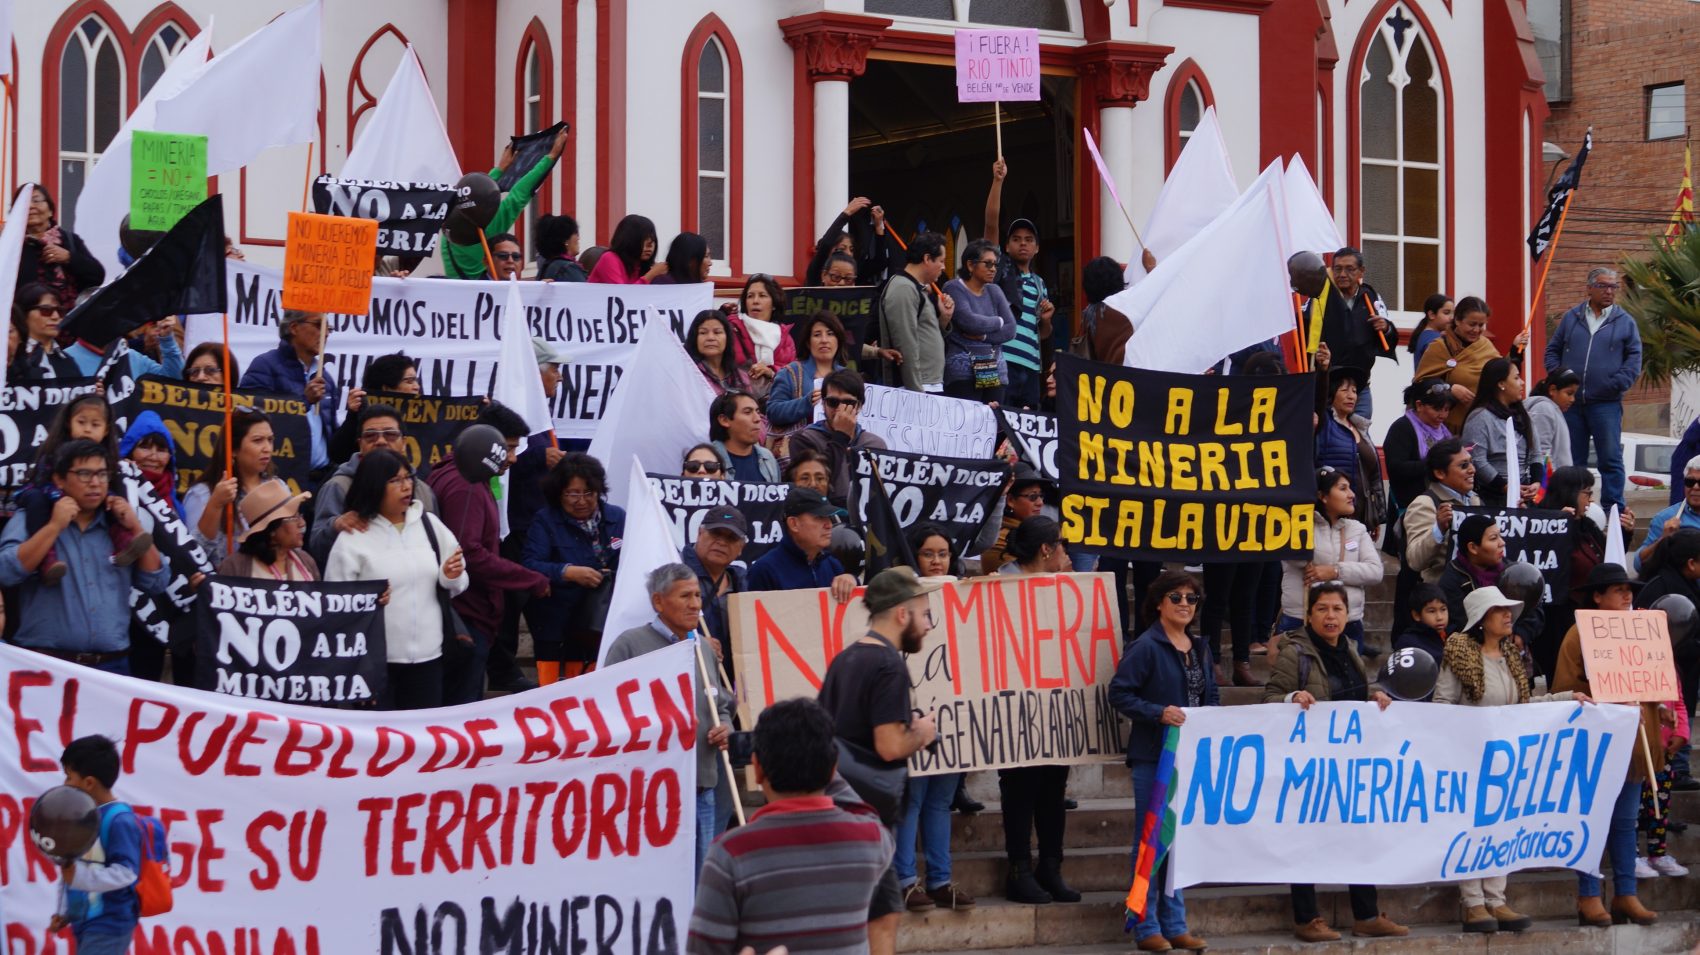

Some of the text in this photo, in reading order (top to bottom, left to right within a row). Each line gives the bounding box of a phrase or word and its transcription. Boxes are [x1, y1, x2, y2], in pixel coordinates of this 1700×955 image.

[968, 57, 1033, 80] RIO TINTO
[967, 81, 992, 93] BELÉN
[1012, 82, 1034, 93] VENDE
[325, 184, 391, 223] NO
[400, 203, 418, 220] A
[422, 203, 449, 220] LA
[295, 219, 312, 239] NO
[377, 229, 441, 252] ERIA
[344, 247, 360, 267] EN
[235, 273, 686, 344] MADOMOS DEL PUBLO DE BEN
[829, 298, 872, 316] DICE
[445, 404, 480, 421] DICE
[1077, 373, 1278, 436] NO A LA
[1003, 409, 1059, 438] BEL
[856, 450, 1004, 488] BELÉN DICE
[1078, 430, 1291, 491] MINERIA
[744, 484, 789, 503] DICE
[929, 499, 948, 521] A
[953, 502, 985, 524] LA
[1061, 494, 1315, 552] SI A LA VIDA
[1451, 510, 1568, 538] BÉN DICE
[752, 520, 783, 544] LA
[1533, 549, 1558, 570] LA
[210, 584, 378, 618] BELÉN DICE
[216, 611, 368, 672] NO A LA
[943, 573, 1120, 695] MINERA
[1592, 612, 1661, 641] BELÉN
[1593, 649, 1613, 660] DICE
[1619, 644, 1644, 666] NO
[1655, 649, 1666, 661] LA
[215, 667, 372, 702] MINERIA
[1597, 665, 1672, 695] MINERÍA
[122, 697, 416, 779] PUEBLO
[418, 718, 503, 773] DE
[513, 672, 698, 765] BELEN
[1289, 709, 1362, 744] A LA
[1181, 704, 1612, 828] NO MINERÍA EN BELÉN
[246, 805, 327, 891] SU
[358, 767, 681, 877] TERRITORIO
[1441, 821, 1590, 879] (Libertarias)
[380, 900, 467, 955] NO
[480, 894, 680, 955] MINERIA
